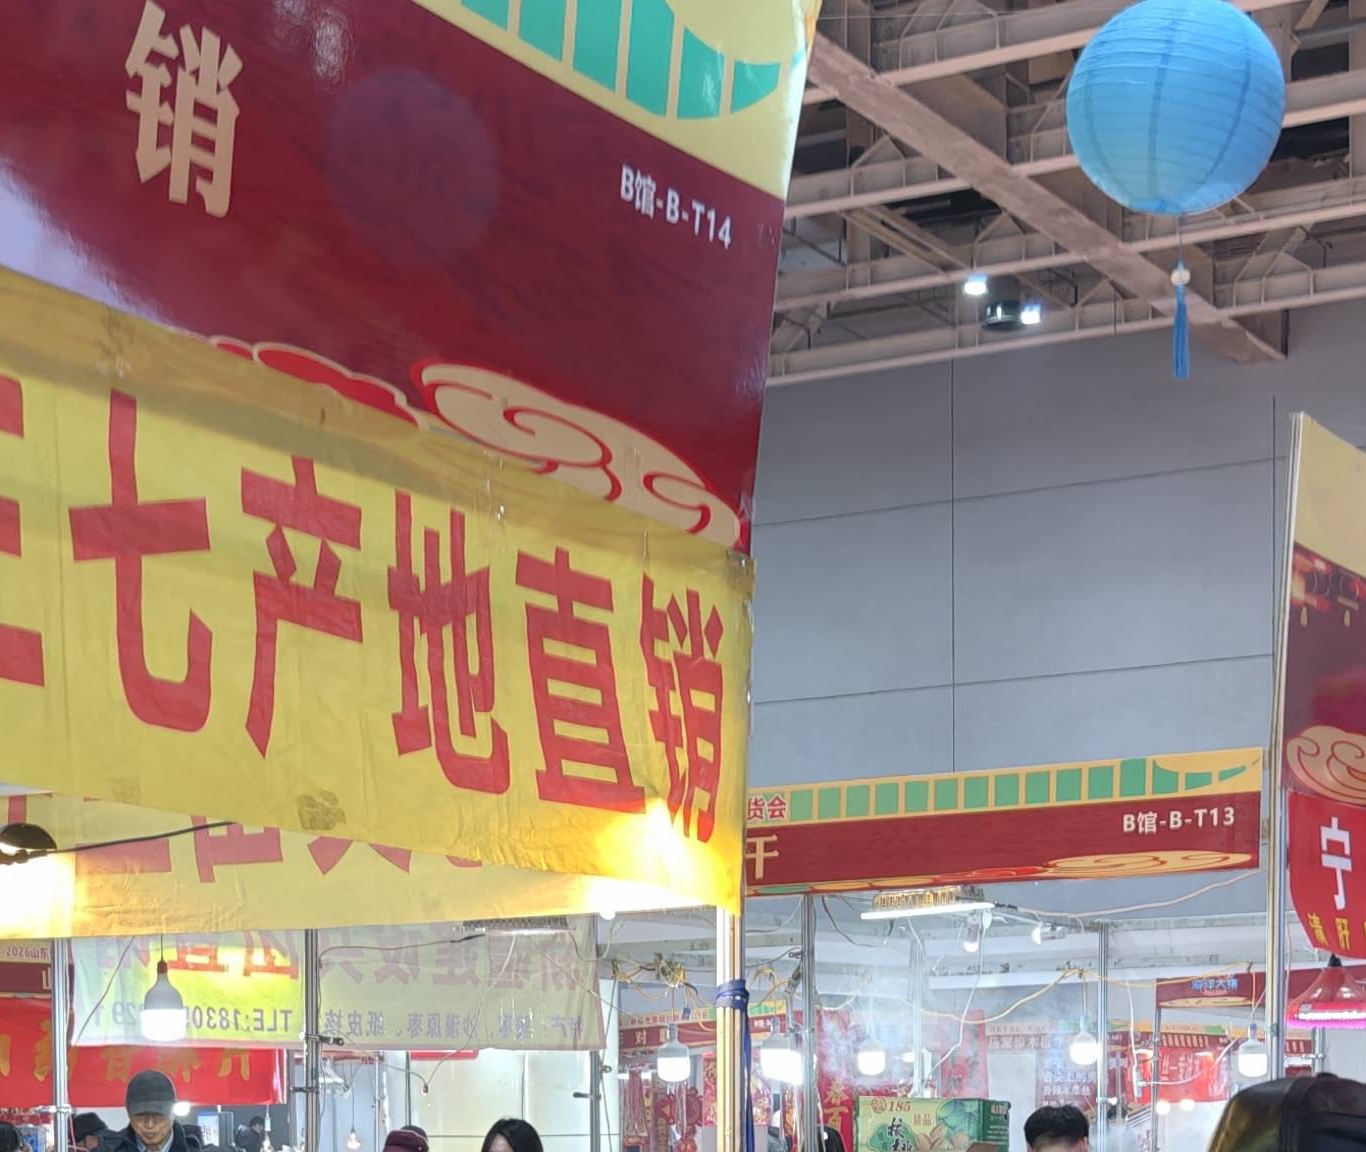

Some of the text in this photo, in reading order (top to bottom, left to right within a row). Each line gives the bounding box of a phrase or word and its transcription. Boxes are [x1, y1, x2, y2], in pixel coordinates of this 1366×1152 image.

[620, 163, 733, 250] B馆-B-T14
[1122, 806, 1237, 836] B馆-B-T13
[889, 1100, 911, 1112] 185
